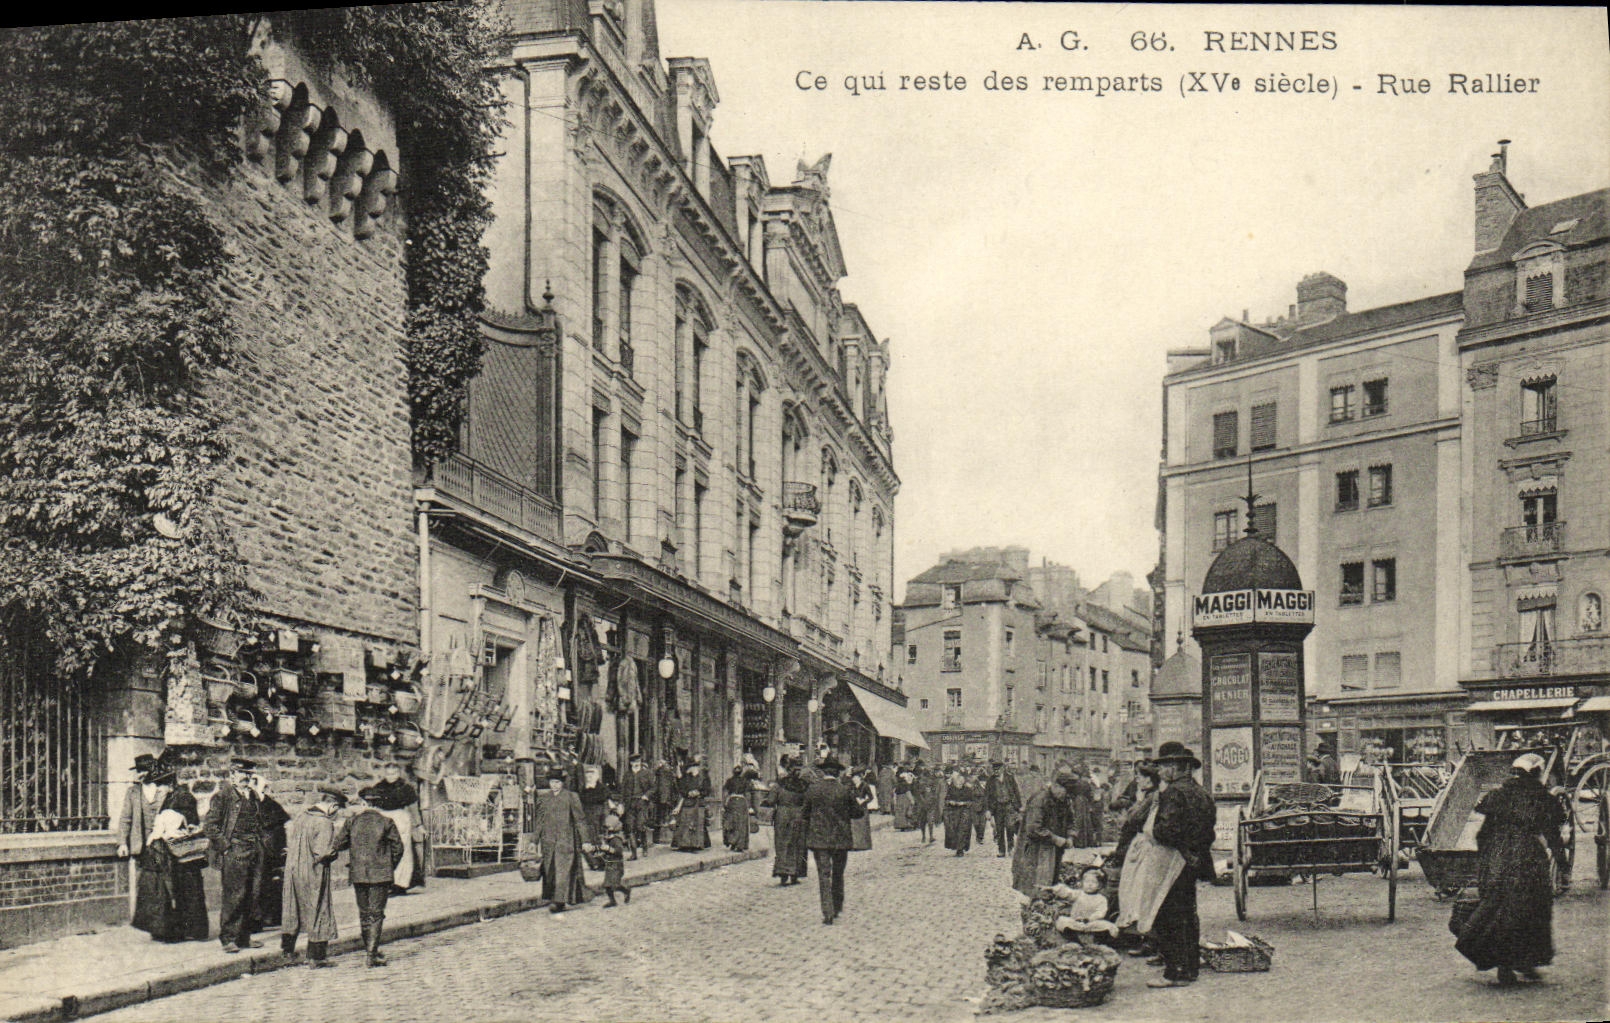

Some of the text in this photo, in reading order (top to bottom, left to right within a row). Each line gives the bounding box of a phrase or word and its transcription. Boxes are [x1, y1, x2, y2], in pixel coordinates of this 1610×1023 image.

[1195, 591, 1251, 616] MAGGI
[1258, 590, 1312, 611] MAGGI
[1212, 673, 1250, 687] CHOCOLAT
[1214, 689, 1249, 701] MENIER
[1493, 687, 1575, 700] CHAPELLERIE
[1215, 746, 1249, 765] MAGGI
